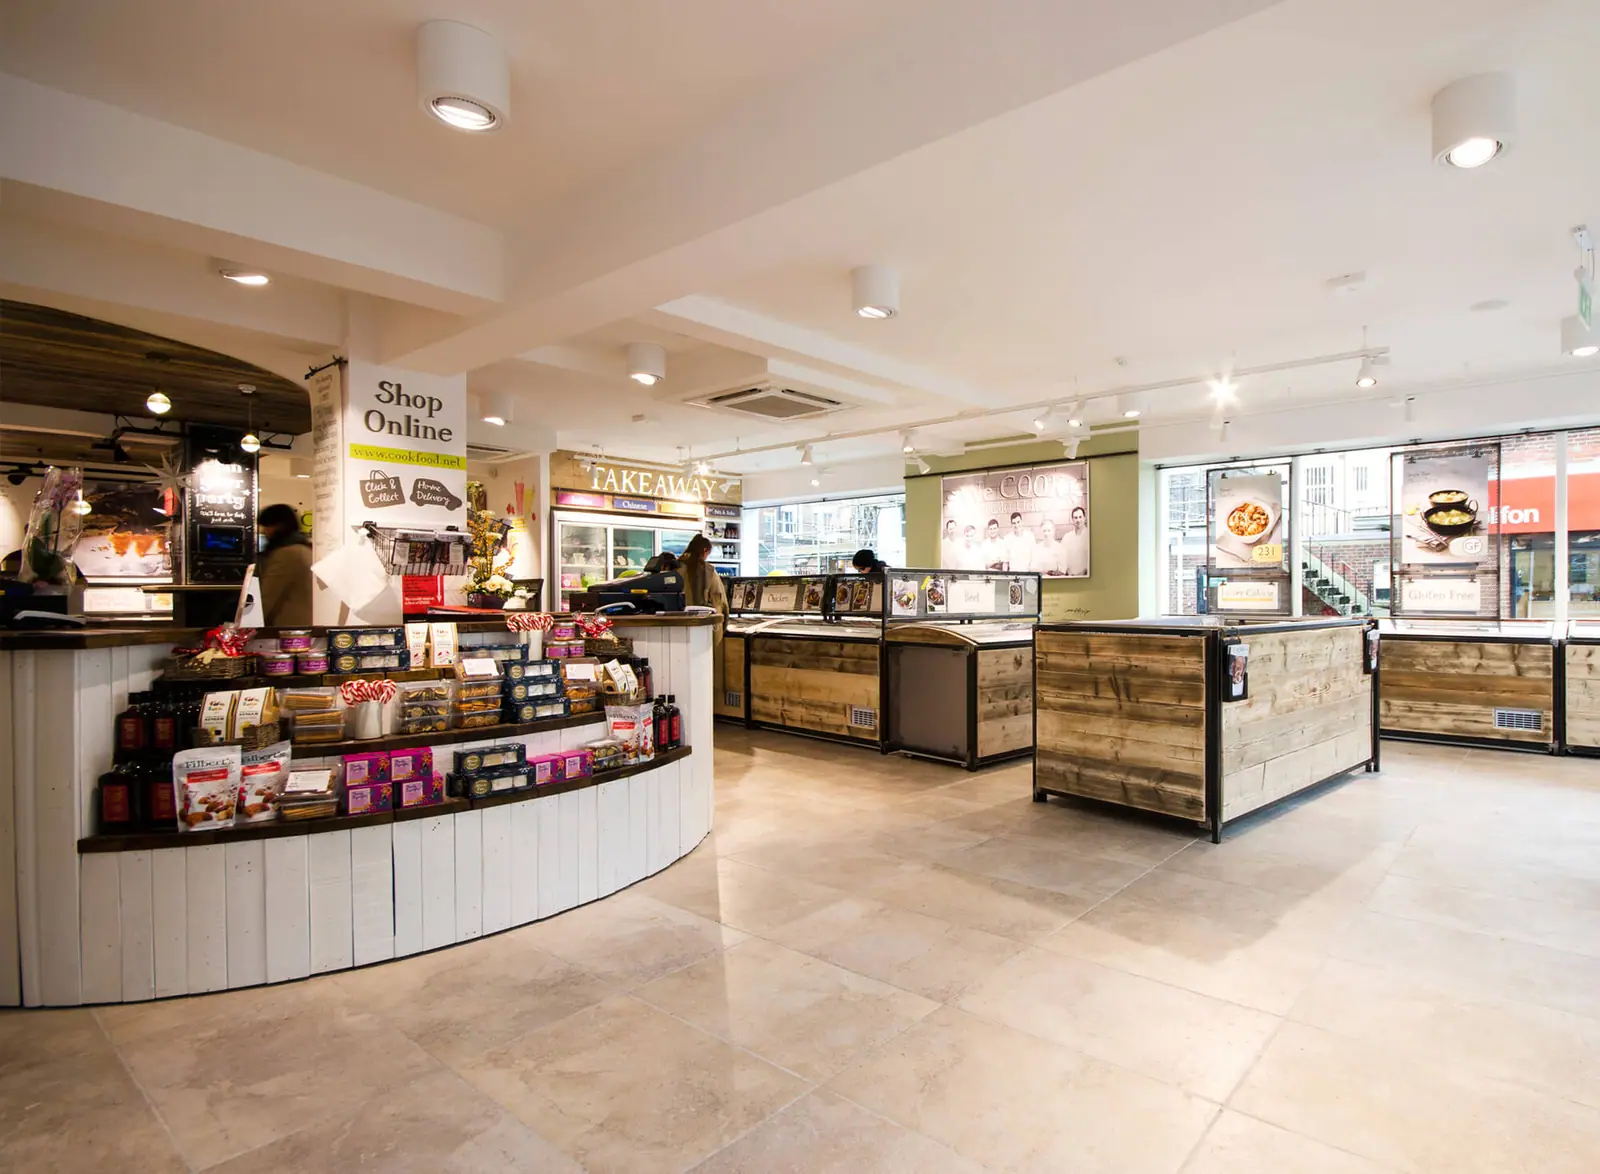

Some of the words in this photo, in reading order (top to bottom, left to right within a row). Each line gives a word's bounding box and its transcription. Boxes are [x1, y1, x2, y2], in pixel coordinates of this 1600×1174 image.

[374, 380, 443, 418] Shop
[364, 409, 453, 442] Online
[353, 448, 461, 467] www.cookfood.net
[365, 482, 388, 493] Click
[389, 479, 397, 491] &
[418, 481, 442, 492] Home
[586, 467, 717, 501] TAKEAWAY
[368, 492, 400, 504] Collect
[416, 490, 450, 506] Delivery
[622, 500, 648, 511] Chinese
[1258, 546, 1275, 557] 231
[1464, 540, 1479, 551] GF
[1408, 590, 1446, 600] Gluten
[1450, 590, 1475, 601] Free
